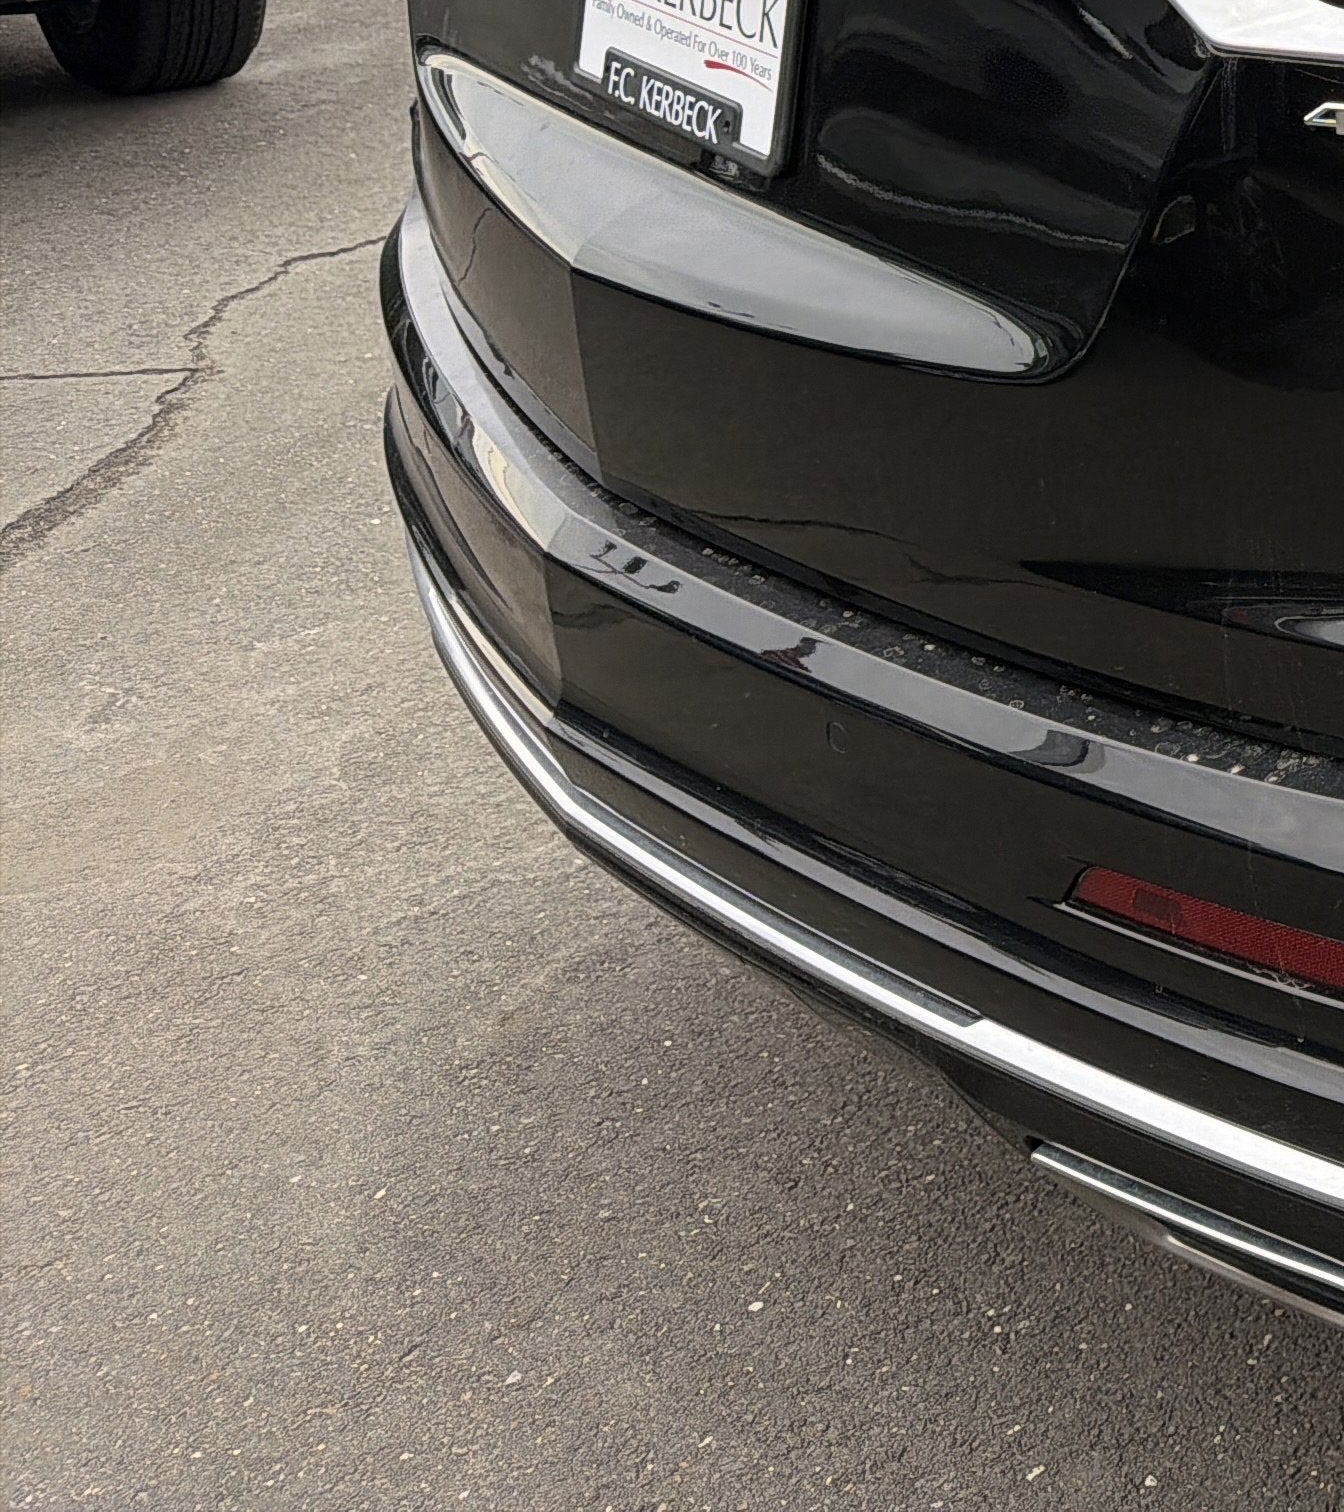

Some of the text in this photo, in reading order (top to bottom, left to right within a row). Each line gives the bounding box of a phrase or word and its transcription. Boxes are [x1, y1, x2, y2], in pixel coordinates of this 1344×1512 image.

[616, 3, 645, 29] Owned
[645, 17, 652, 32] &
[653, 18, 693, 49] Operated
[692, 36, 707, 54] For
[707, 40, 730, 63] Over
[732, 52, 748, 70] 100
[749, 55, 773, 82] Years
[638, 75, 723, 145] KERBECK
